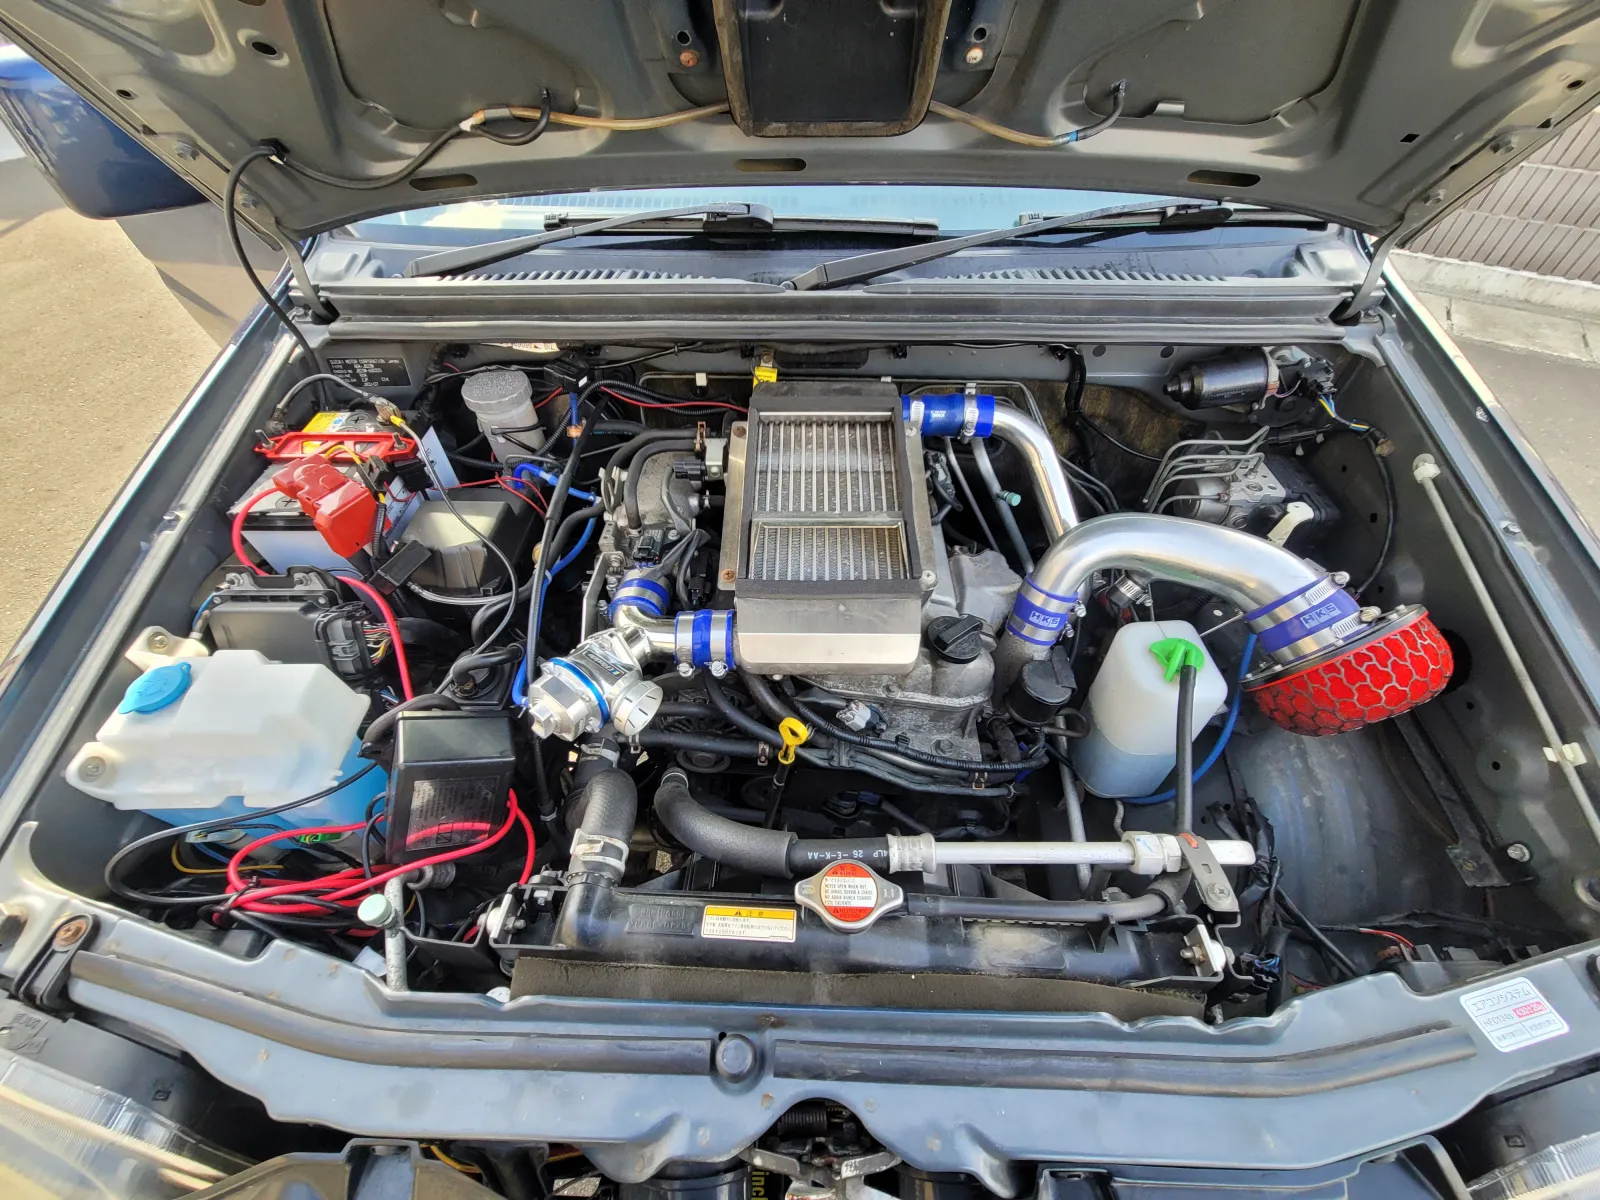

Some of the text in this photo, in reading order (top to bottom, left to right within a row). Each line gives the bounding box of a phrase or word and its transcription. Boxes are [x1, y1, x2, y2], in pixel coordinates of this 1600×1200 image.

[1029, 611, 1060, 627] HKS
[1300, 602, 1342, 629] HKS
[853, 850, 864, 858] 26
[1471, 987, 1532, 1012] エアコンシステム
